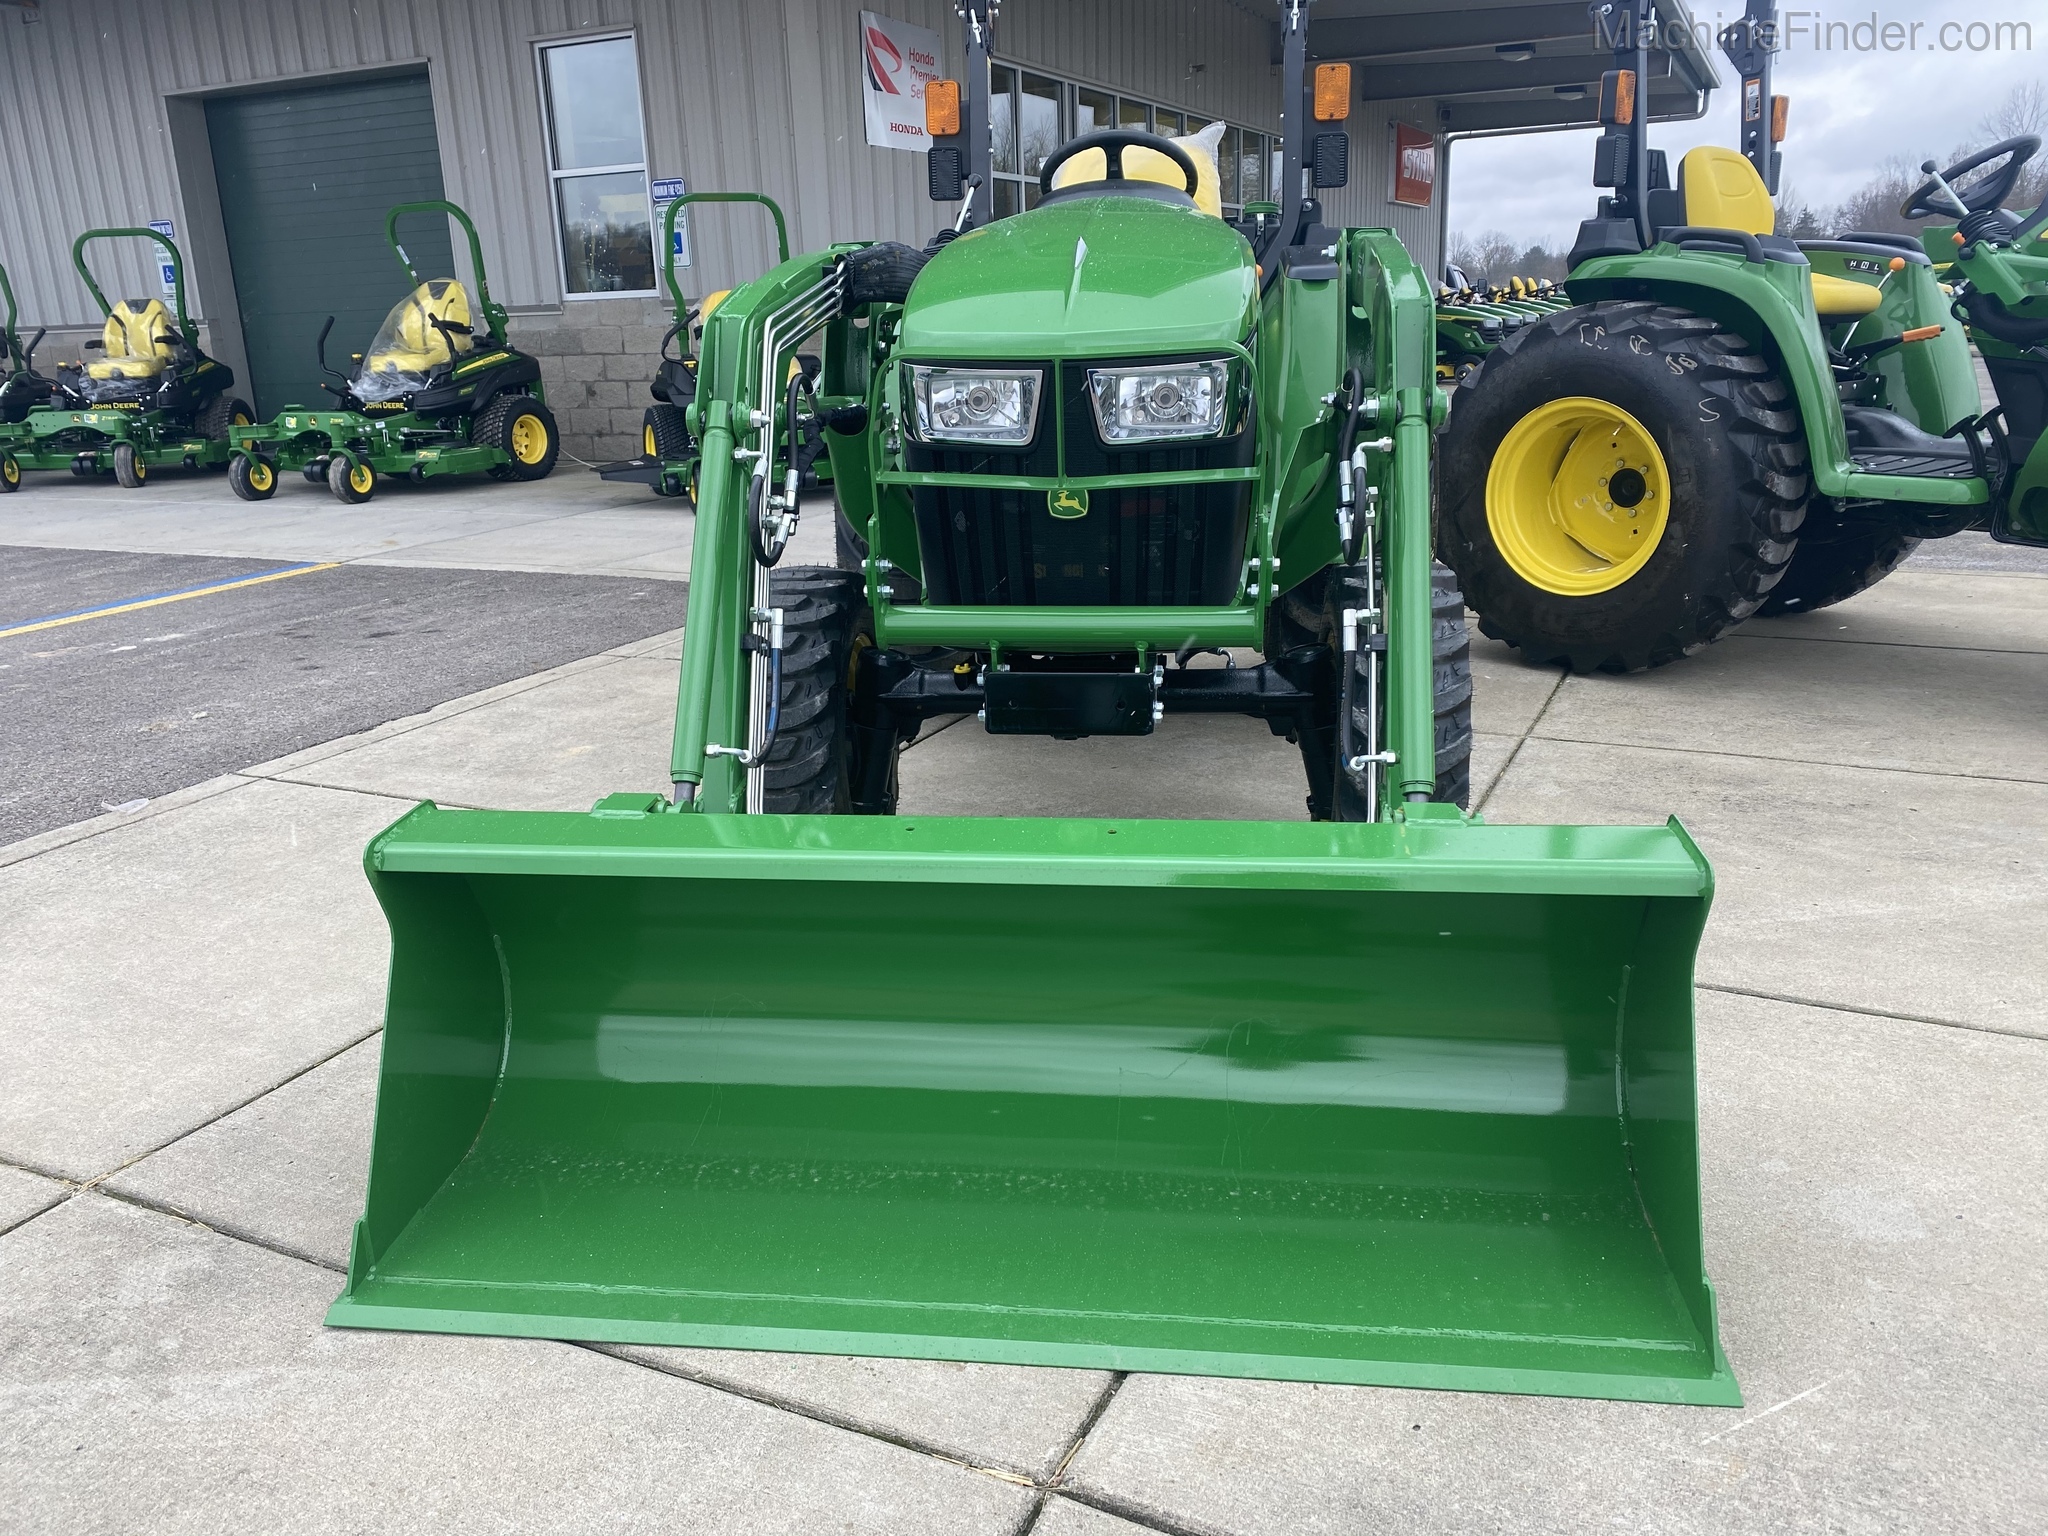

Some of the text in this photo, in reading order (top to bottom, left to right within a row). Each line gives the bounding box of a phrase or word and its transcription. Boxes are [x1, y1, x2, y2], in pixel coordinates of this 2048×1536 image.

[908, 47, 935, 67] Honda
[910, 66, 940, 82] Premier
[890, 122, 924, 136] HONDA
[656, 209, 685, 218] RESED
[659, 222, 685, 230] PING
[383, 401, 405, 409] DEERE
